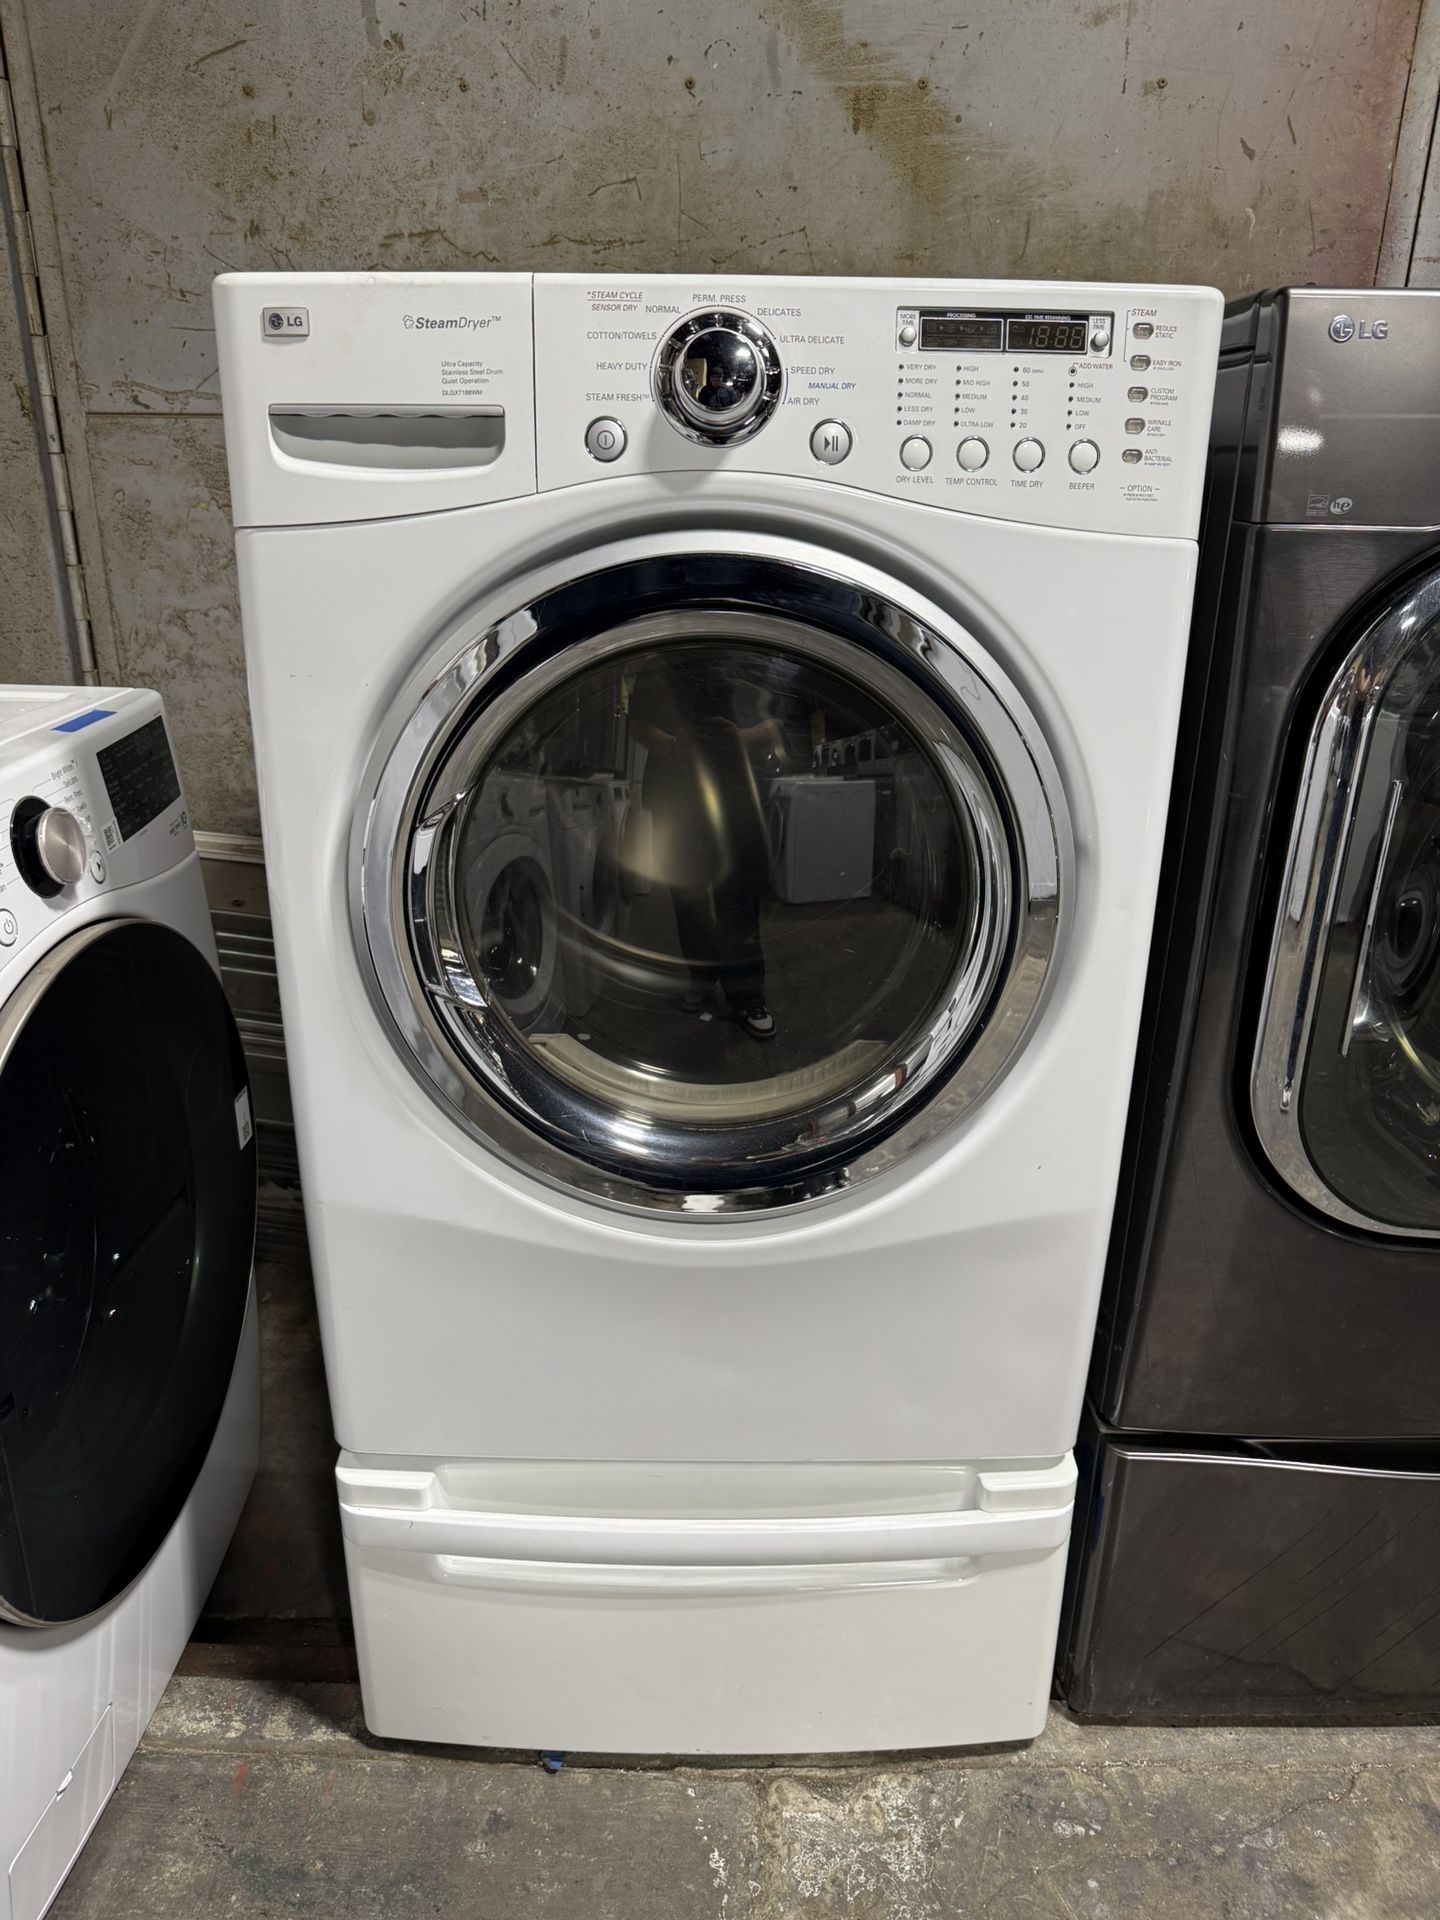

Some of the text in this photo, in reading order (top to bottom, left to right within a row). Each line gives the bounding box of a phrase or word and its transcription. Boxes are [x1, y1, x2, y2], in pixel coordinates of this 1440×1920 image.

[620, 292, 643, 300] CYCLE
[692, 293, 746, 304] PERM. PRESS
[591, 304, 638, 312] SENSOR DRY
[645, 305, 681, 314] NORMAL
[757, 307, 802, 317] DELICATES
[1131, 308, 1157, 317] STEAM
[587, 331, 658, 340] COTTON/TOWELS
[780, 335, 845, 344] ULTRA DELICATE
[457, 360, 483, 368] Capacity
[596, 362, 648, 370] HEAVY DUTY
[906, 363, 922, 371] VERY
[790, 366, 836, 375] SPEED DRY
[459, 377, 490, 385] Operation
[808, 382, 857, 390] MANUAL DRY
[585, 393, 614, 401] STEAM
[787, 397, 820, 406] AIR DRY
[912, 476, 934, 484] LEVEL
[945, 477, 998, 486] TEMP. CONTROL
[1011, 480, 1044, 488] TIME DRY
[1069, 482, 1095, 490] BEEPER
